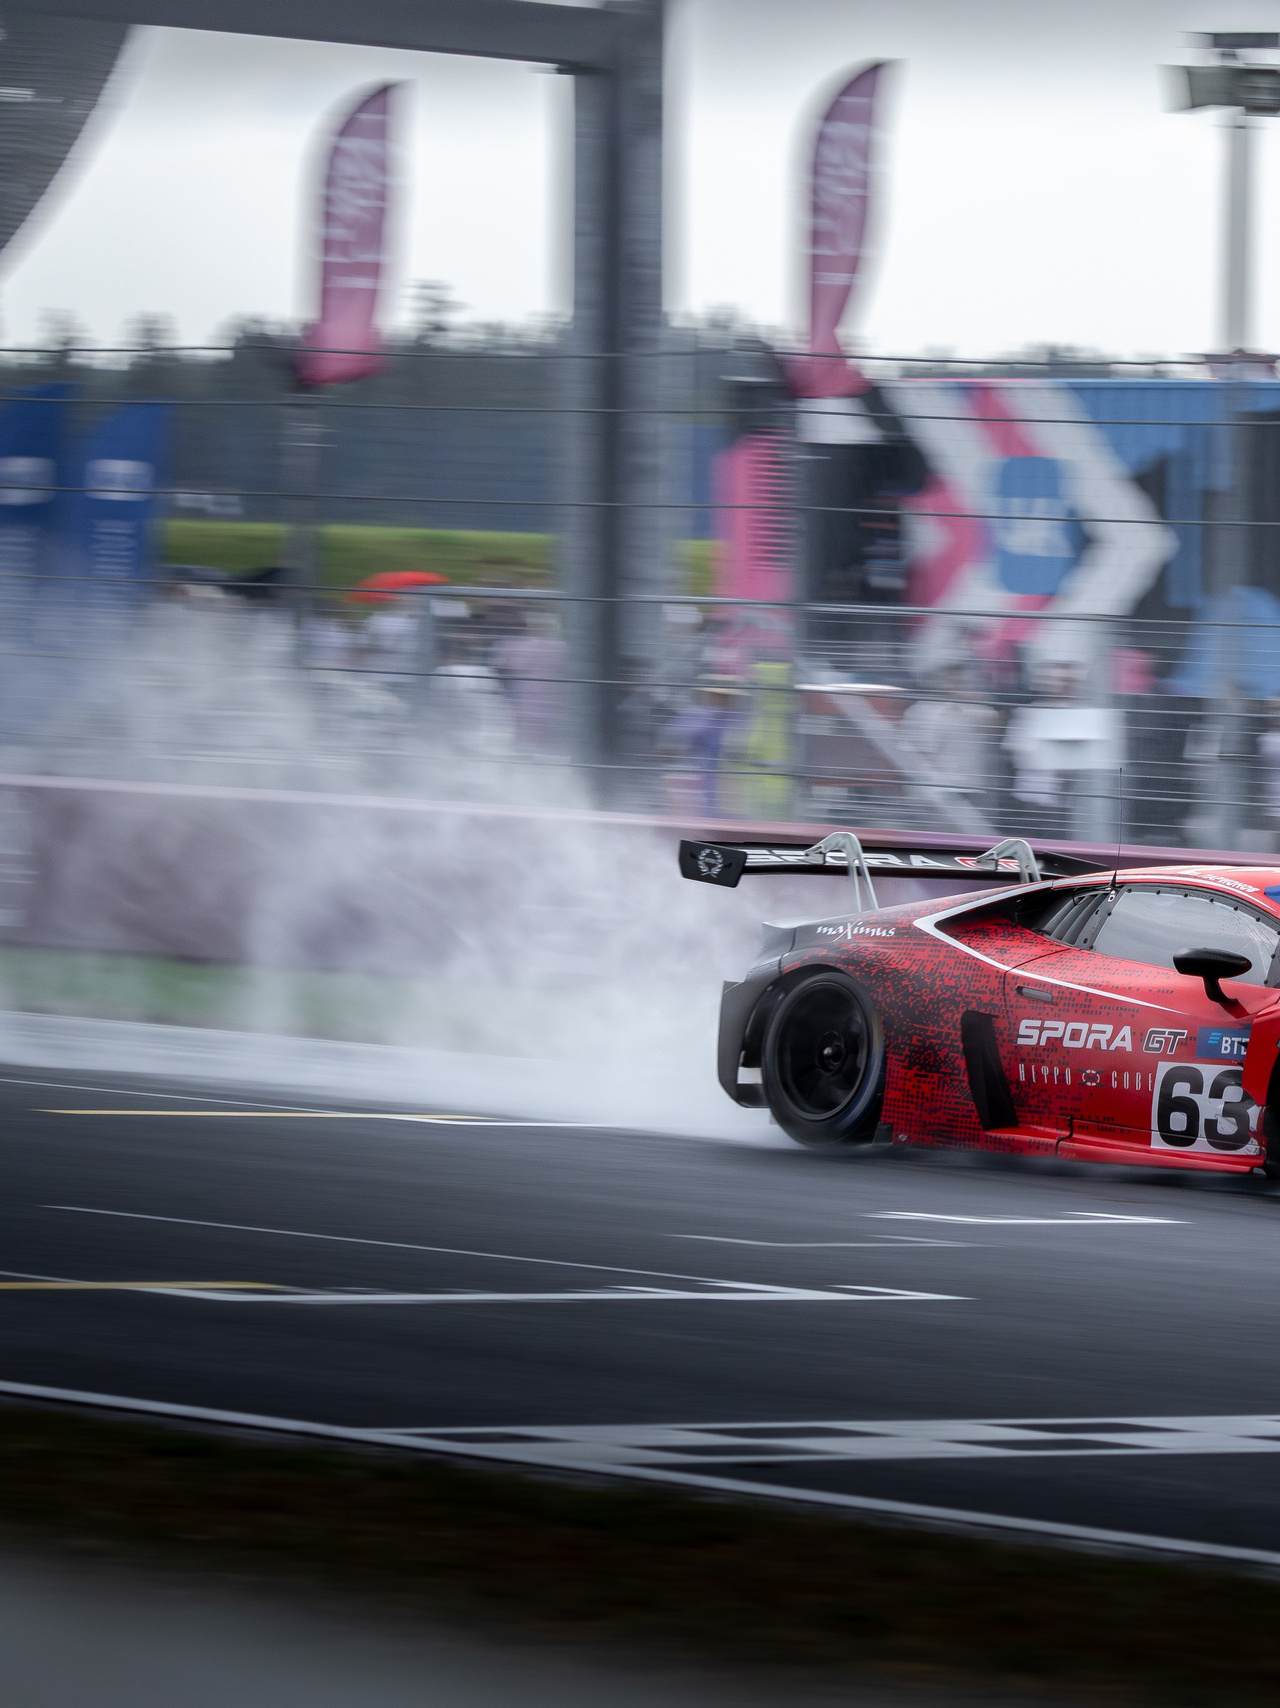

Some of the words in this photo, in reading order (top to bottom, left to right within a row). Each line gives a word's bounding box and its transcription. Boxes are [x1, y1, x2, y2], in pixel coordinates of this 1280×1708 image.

[1017, 1020, 1133, 1052] SPORA
[1142, 1028, 1188, 1055] GT
[1157, 1066, 1257, 1151] 63
